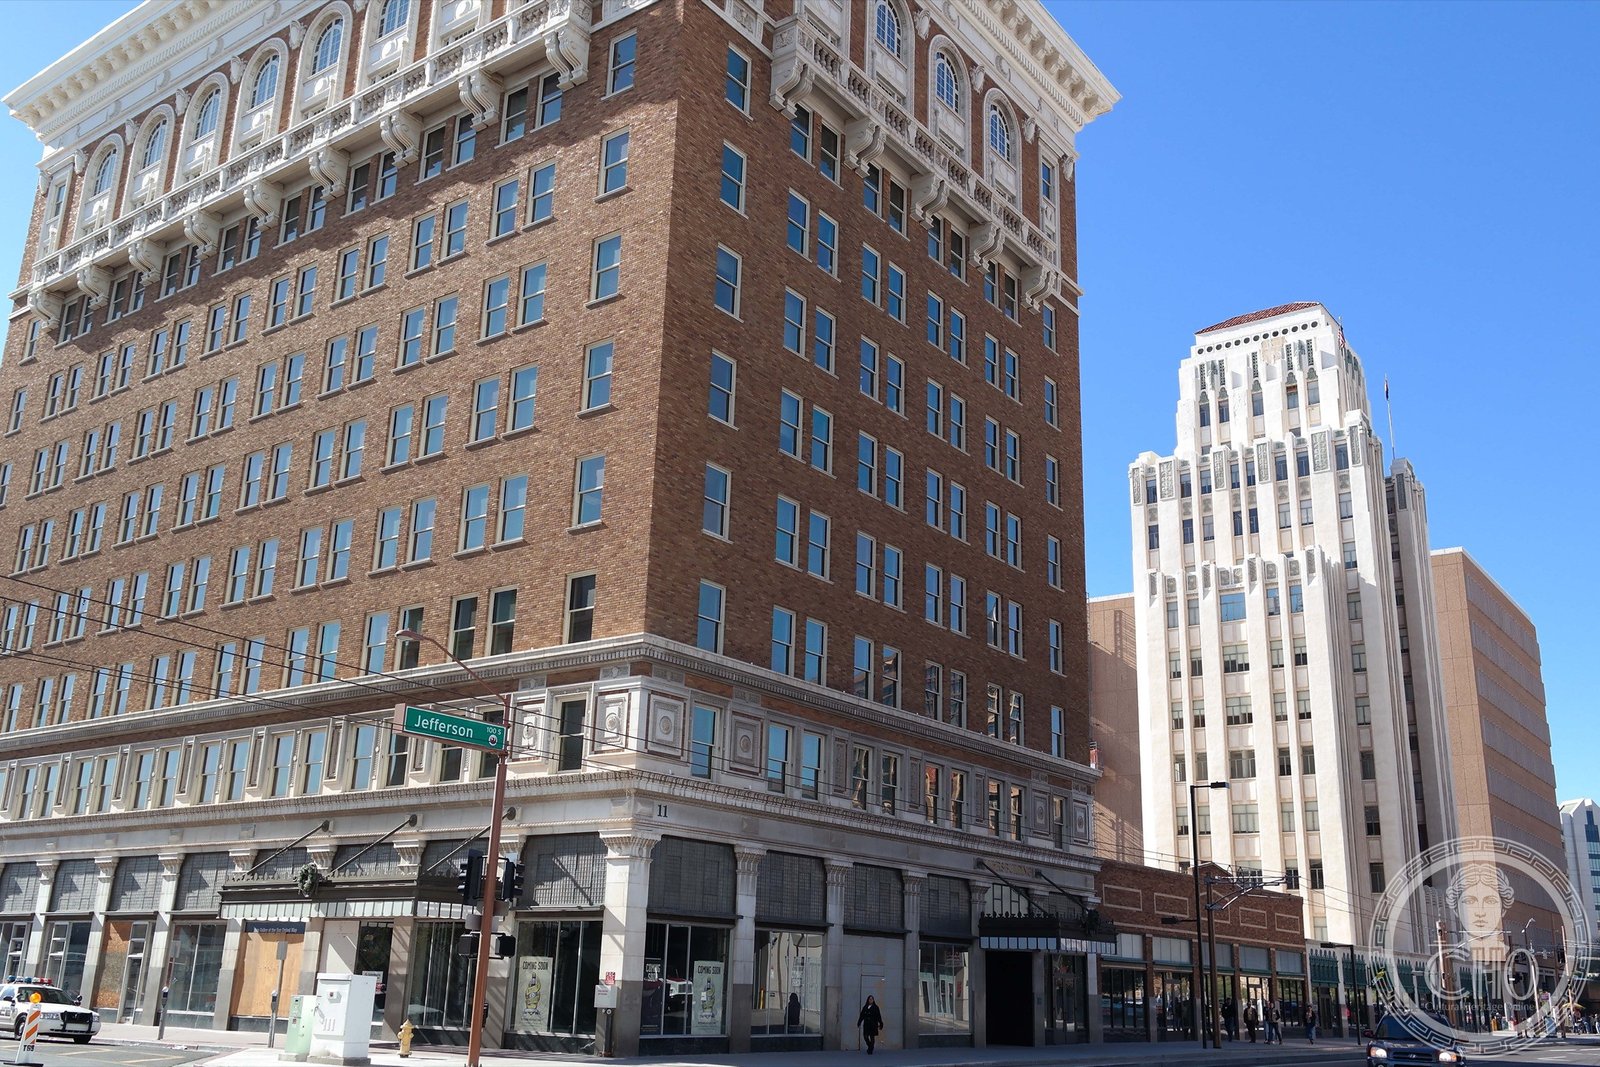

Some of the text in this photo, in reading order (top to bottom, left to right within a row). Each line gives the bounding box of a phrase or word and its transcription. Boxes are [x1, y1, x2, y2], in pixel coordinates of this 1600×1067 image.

[414, 715, 474, 738] Jefferson
[486, 726, 497, 734] 100
[657, 804, 668, 818] 11
[523, 961, 548, 970] COMING SOON
[698, 966, 711, 974] COMING
